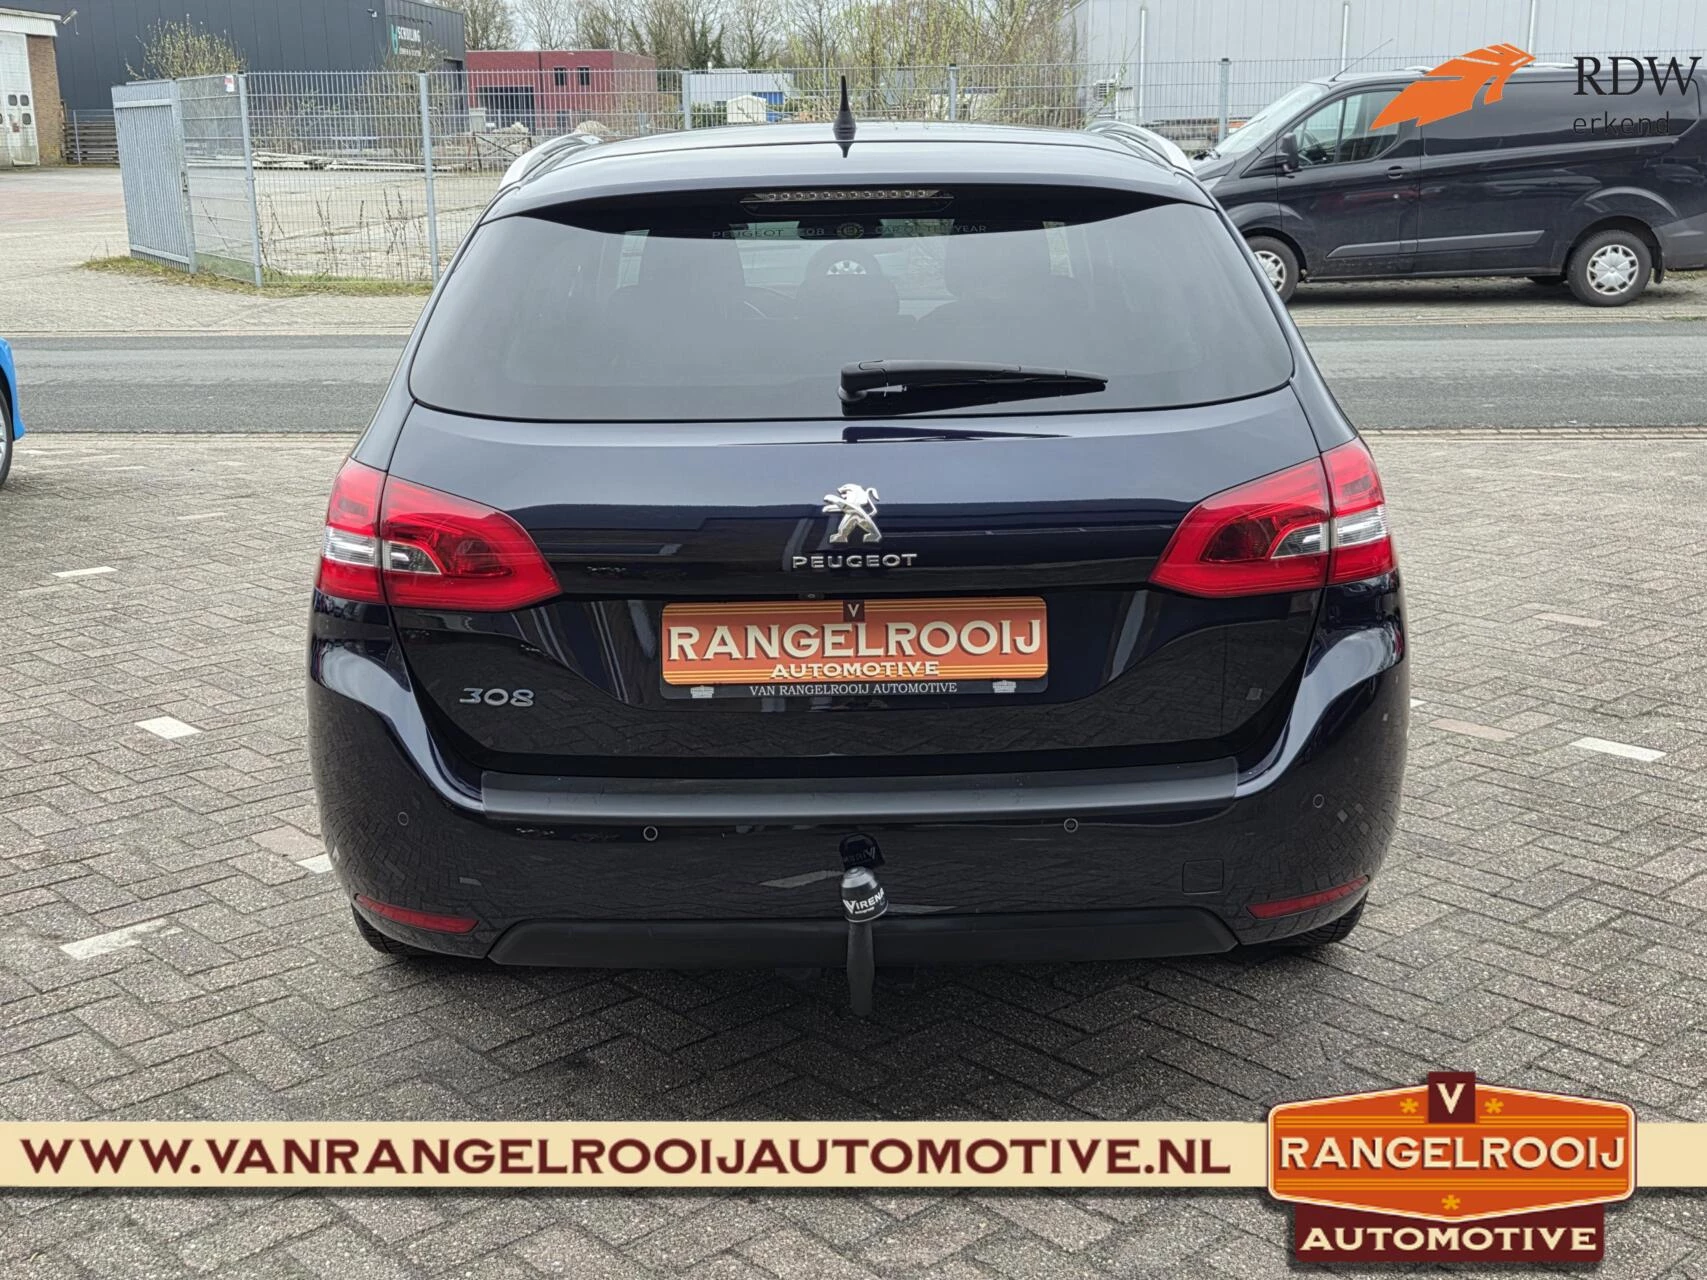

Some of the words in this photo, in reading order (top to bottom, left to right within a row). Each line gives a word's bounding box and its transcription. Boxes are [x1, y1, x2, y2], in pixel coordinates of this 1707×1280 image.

[712, 229, 784, 239] PEUGEOT
[954, 225, 987, 233] YEAR
[792, 553, 918, 569] PEUGEOT
[848, 603, 859, 617] V
[668, 619, 1041, 660] RANGELROOIJ
[770, 661, 940, 679] AUTOMOTIVE
[459, 687, 535, 707] 308
[749, 685, 776, 696] VAN
[779, 683, 869, 696] RANGELROOIJ
[873, 682, 958, 694] AUTOMOTIVE
